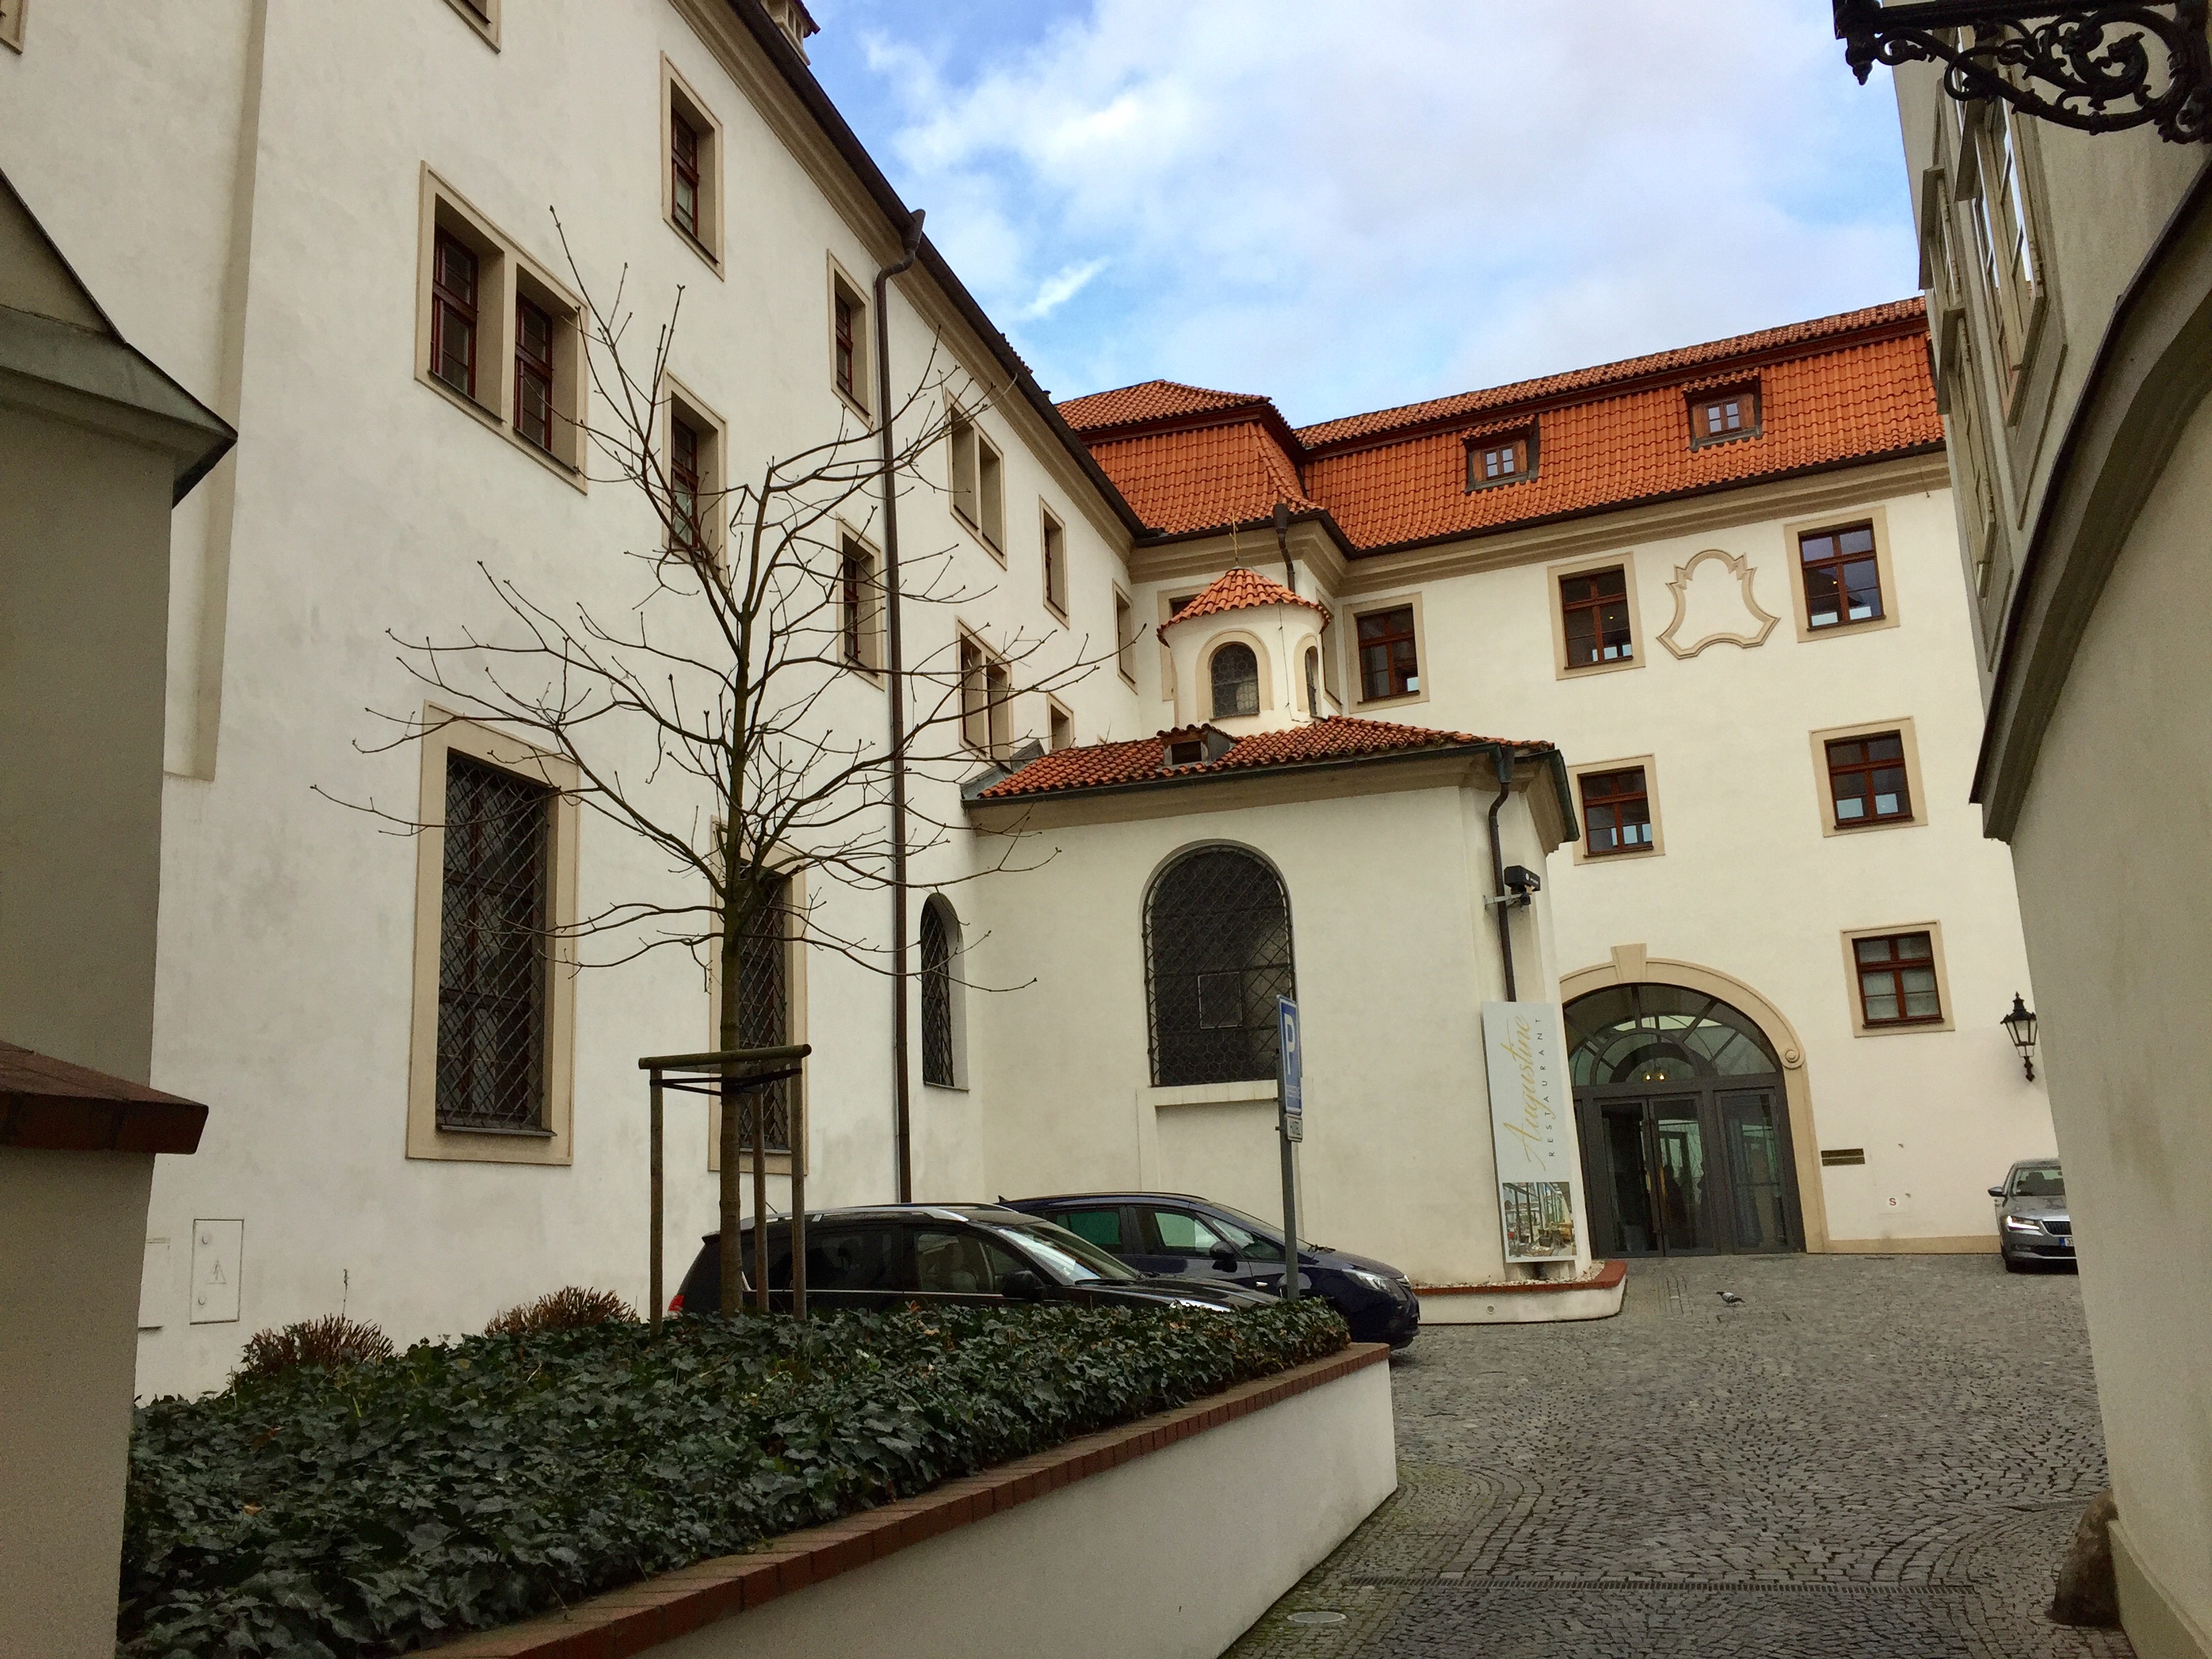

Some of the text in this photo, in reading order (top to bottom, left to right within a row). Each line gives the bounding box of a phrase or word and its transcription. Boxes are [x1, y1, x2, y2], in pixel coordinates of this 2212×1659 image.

[1284, 1013, 1295, 1076] P
[1500, 1016, 1556, 1172] Augustine
[1535, 1019, 1555, 1158] RESTAURANT
